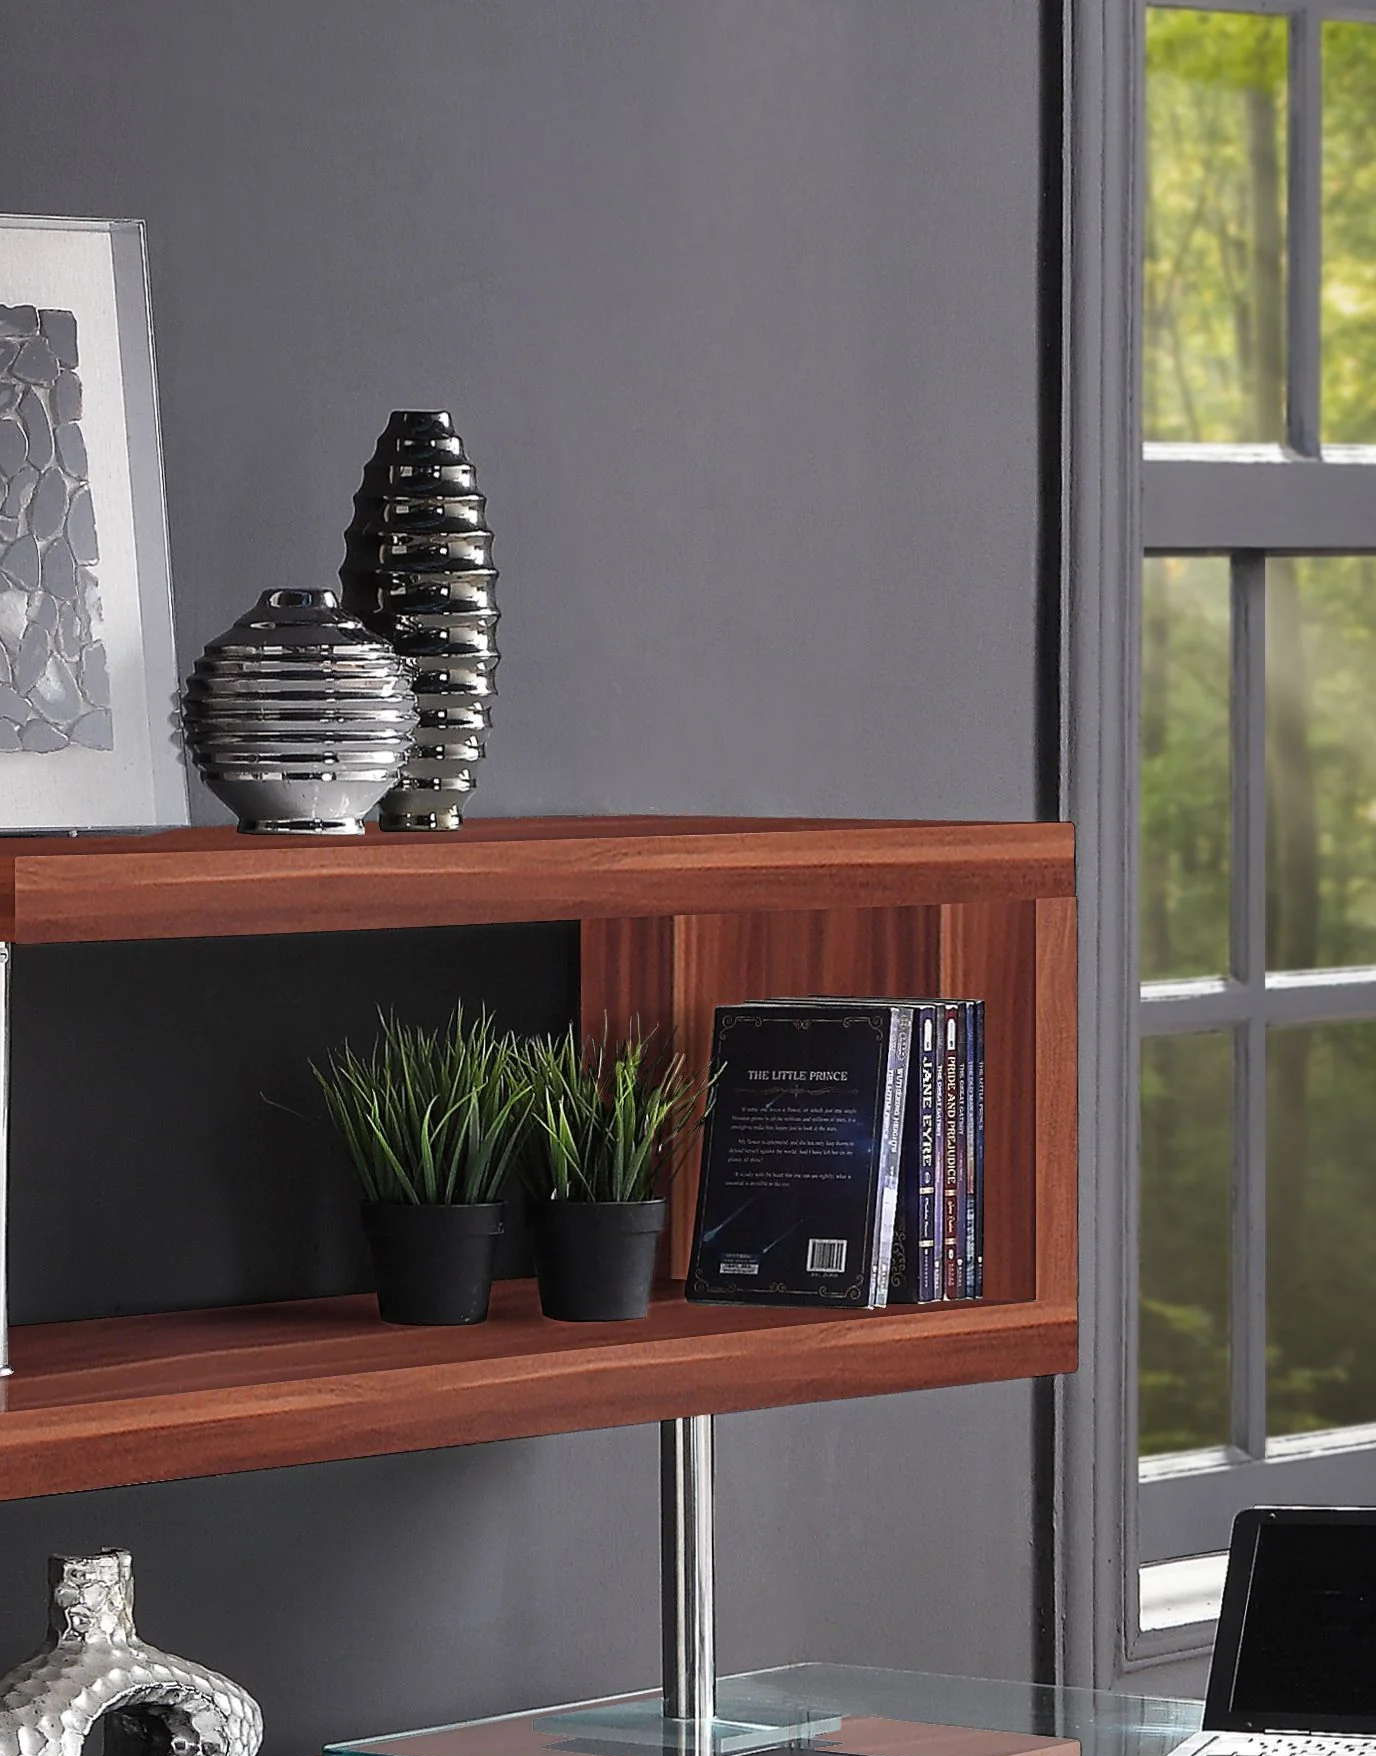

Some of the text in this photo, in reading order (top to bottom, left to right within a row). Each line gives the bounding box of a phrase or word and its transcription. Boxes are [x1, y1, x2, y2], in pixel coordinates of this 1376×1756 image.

[748, 1070, 849, 1082] THE LITTLE PRINCE
[922, 1056, 933, 1108] JANE
[947, 1056, 956, 1090] PRIDE
[947, 1093, 956, 1118] AND
[922, 1115, 933, 1167] EYRE
[947, 1120, 956, 1185] PREJUDICE
